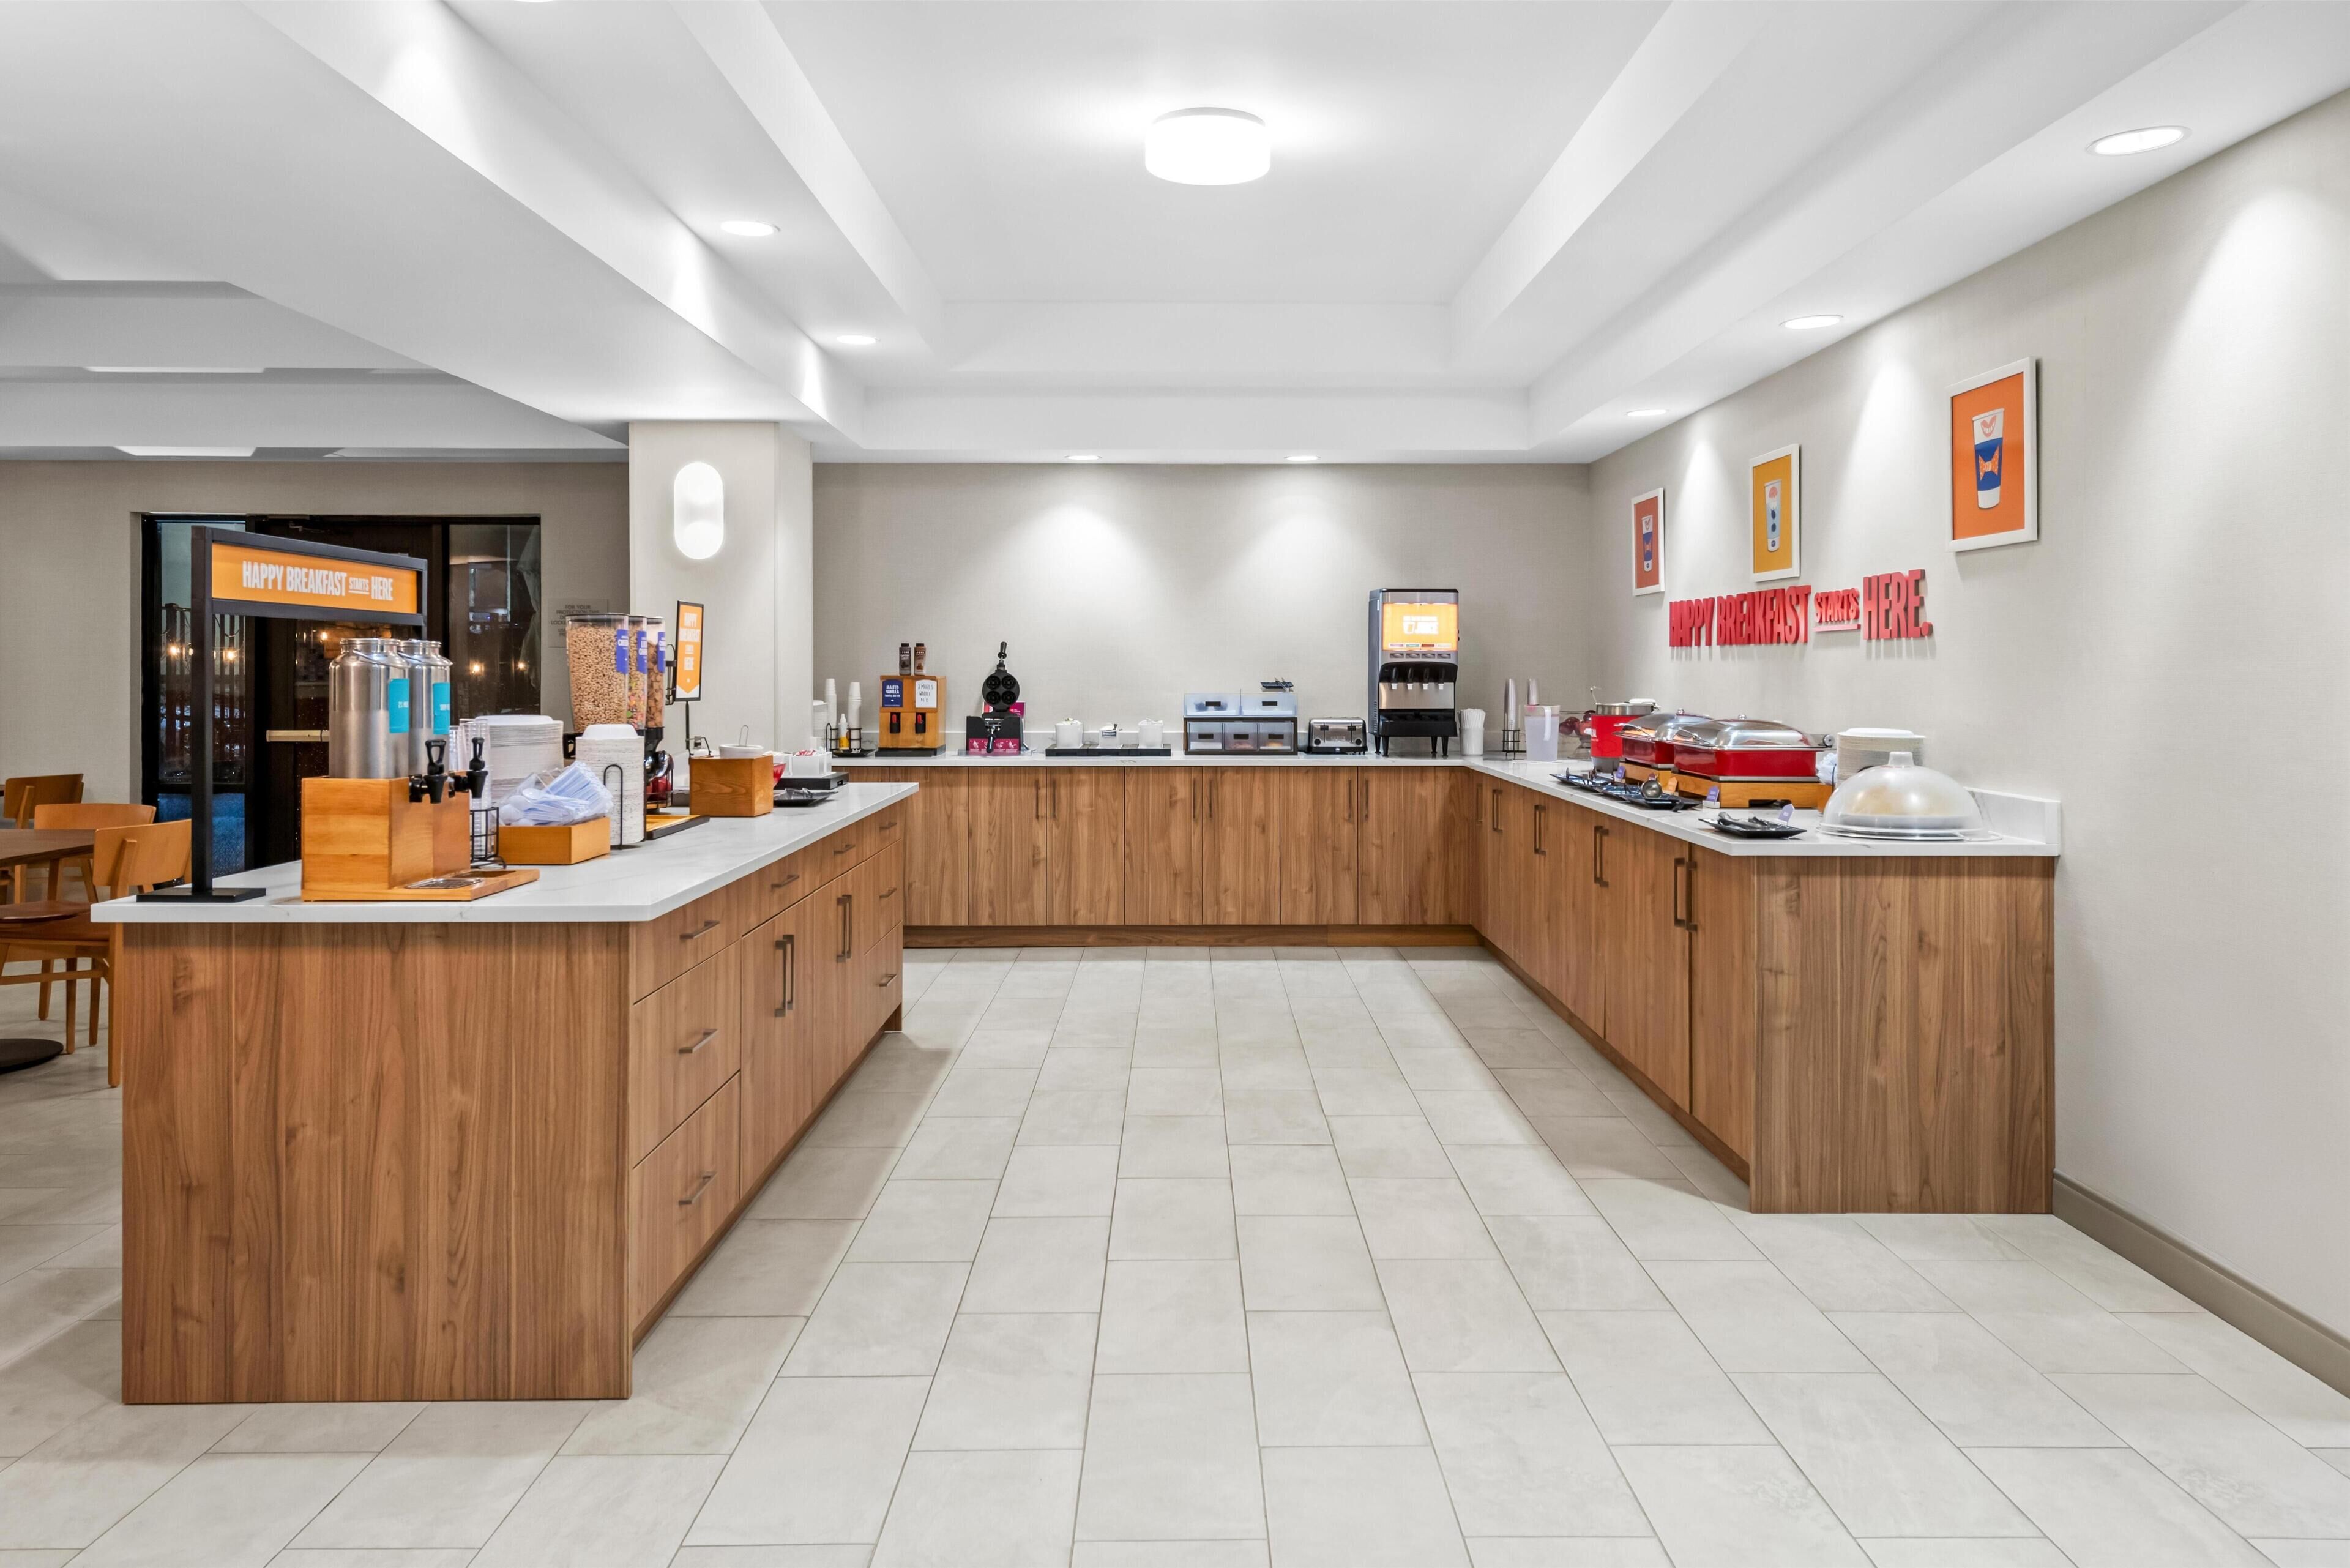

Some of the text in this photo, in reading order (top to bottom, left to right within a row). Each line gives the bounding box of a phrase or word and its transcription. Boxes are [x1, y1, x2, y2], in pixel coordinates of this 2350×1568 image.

[242, 561, 394, 601] HAPPY BREAKFAST STARTS HERE
[1669, 569, 1934, 647] HAPPY BREAKFAST STARTS HERE.
